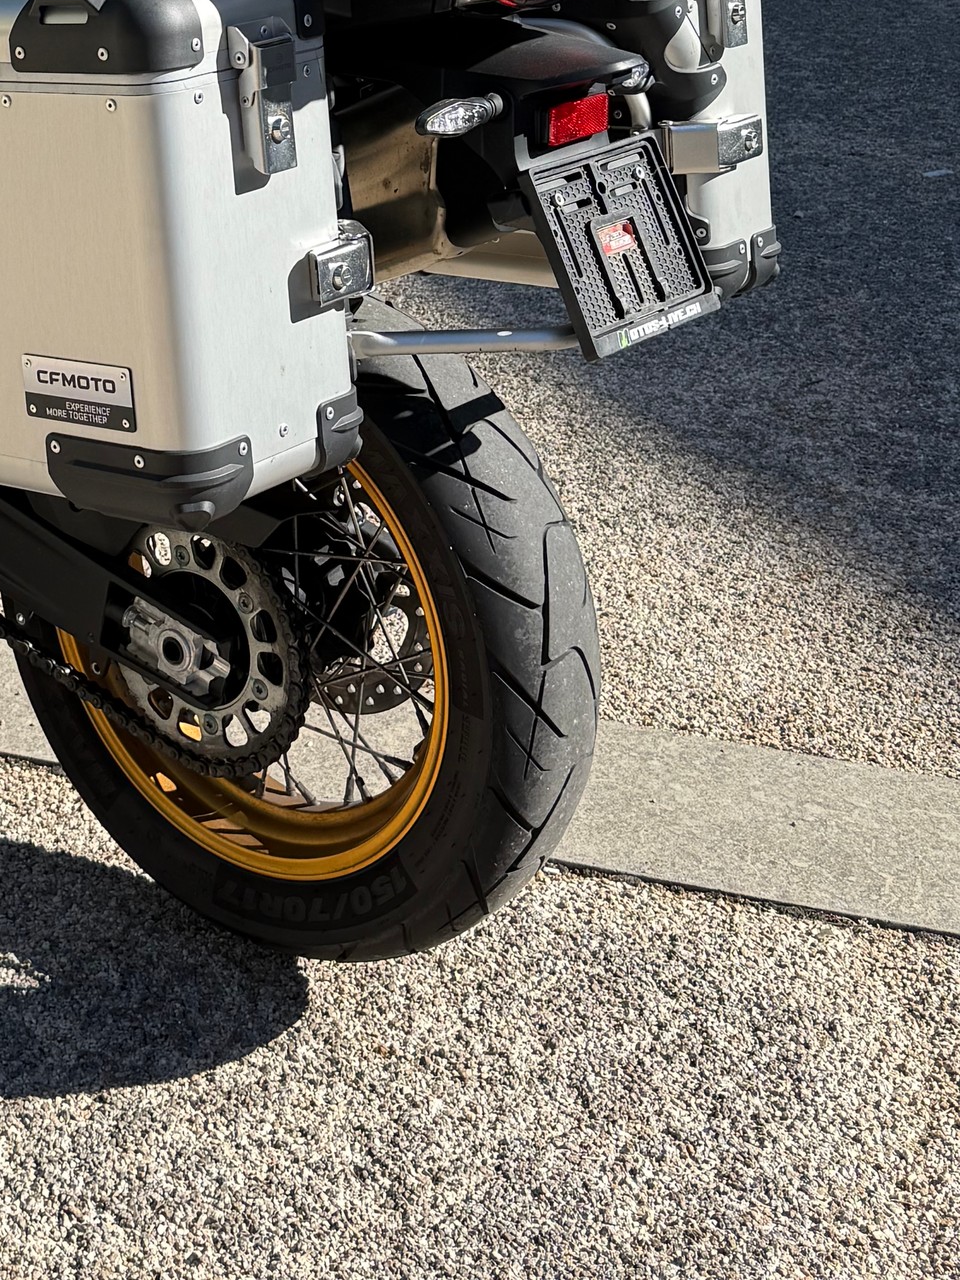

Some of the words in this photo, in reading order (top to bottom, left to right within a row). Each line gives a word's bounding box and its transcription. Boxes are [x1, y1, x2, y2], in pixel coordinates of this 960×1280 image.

[36, 369, 116, 394] CFMOTO
[46, 407, 68, 419] MORE
[68, 410, 108, 425] TOGETHER
[65, 401, 111, 417] EXPERIENCE
[218, 865, 407, 923] 150/70R17
